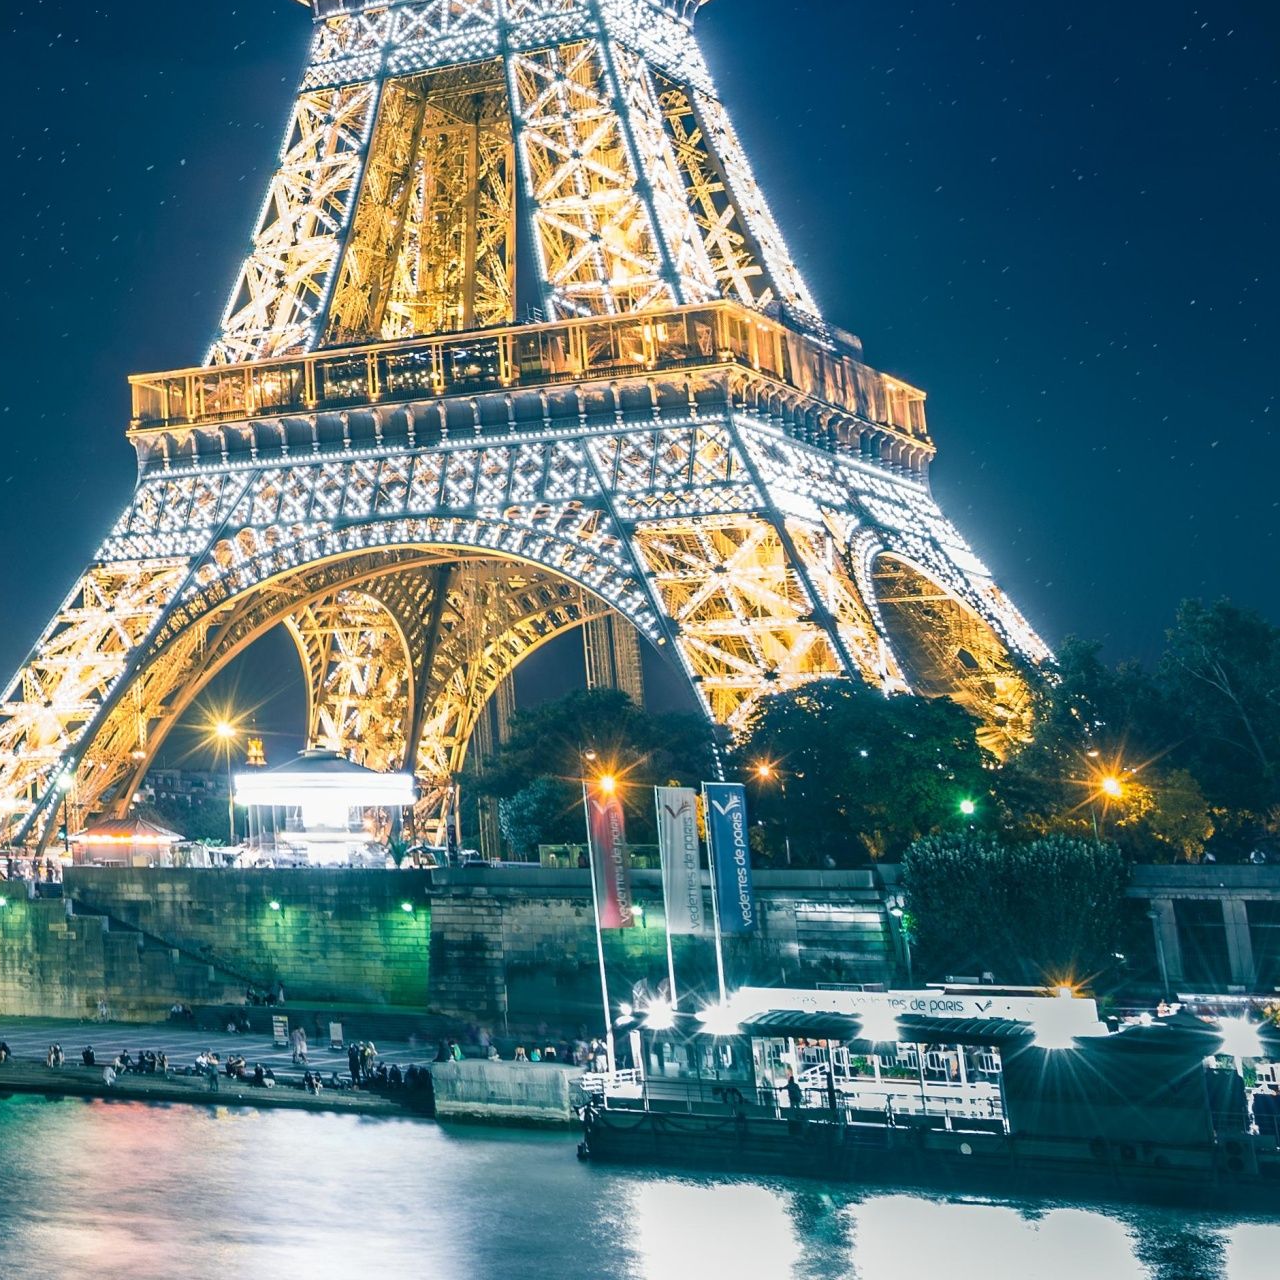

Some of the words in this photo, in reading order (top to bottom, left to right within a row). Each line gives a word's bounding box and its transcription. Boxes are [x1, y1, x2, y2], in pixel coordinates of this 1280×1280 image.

[684, 853, 695, 870] de
[735, 849, 745, 866] de
[910, 998, 926, 1011] de
